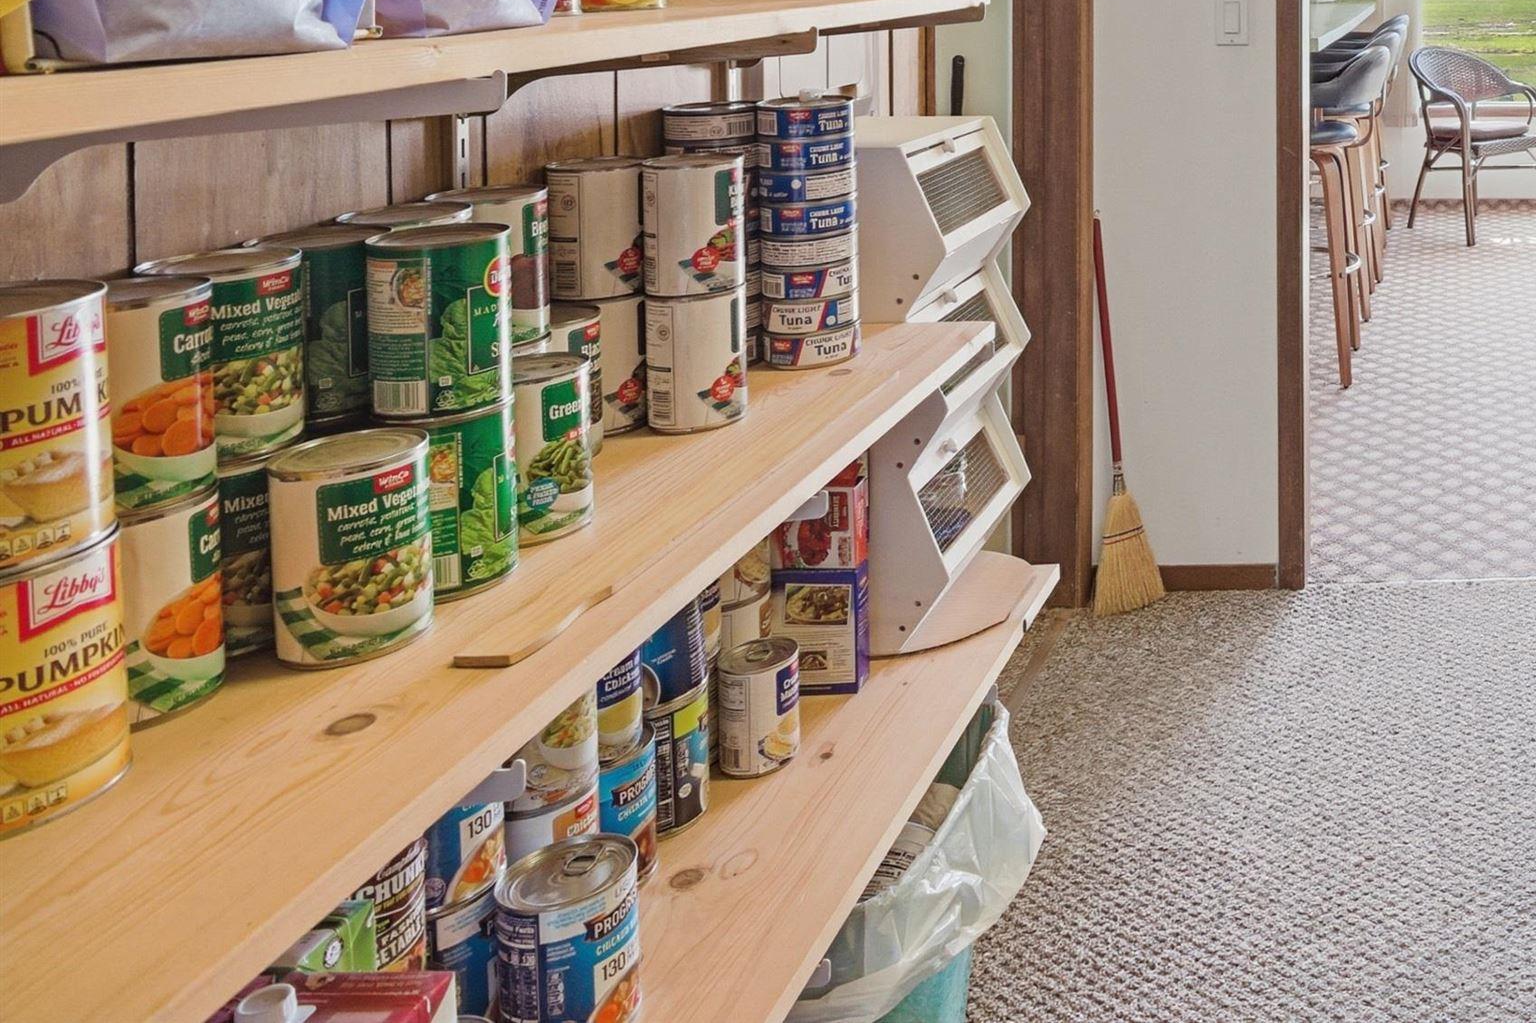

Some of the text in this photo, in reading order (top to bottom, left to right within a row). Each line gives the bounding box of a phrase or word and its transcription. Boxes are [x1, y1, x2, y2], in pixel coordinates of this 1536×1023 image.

[818, 119, 844, 132] Tuna
[809, 153, 838, 164] Tuna
[810, 217, 838, 230] Tuna
[210, 299, 261, 321] Mixed
[778, 315, 813, 326] Tuna
[814, 341, 848, 356] Tuna
[327, 497, 378, 522] Mixed
[37, 567, 105, 615] Libby's
[44, 639, 78, 659] 100%
[468, 809, 492, 839] 130
[601, 951, 626, 981] 130
